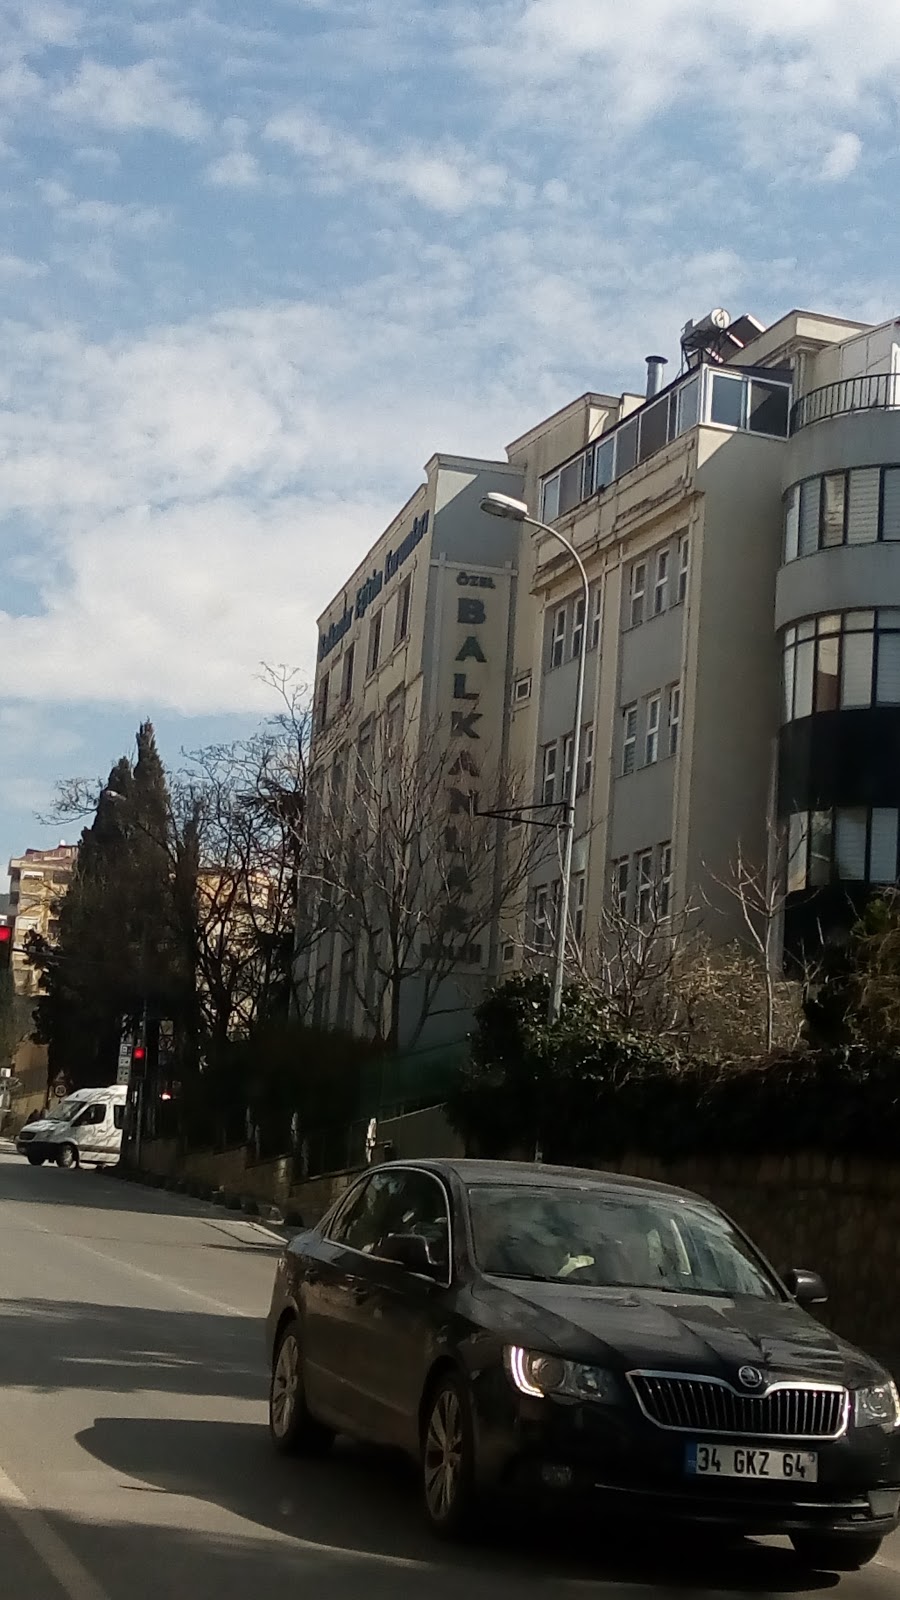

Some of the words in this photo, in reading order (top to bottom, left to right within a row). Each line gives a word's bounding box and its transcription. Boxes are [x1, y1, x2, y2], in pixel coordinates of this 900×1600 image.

[698, 1447, 721, 1473] 34
[733, 1449, 770, 1476] GKZ
[782, 1453, 806, 1478] 64
